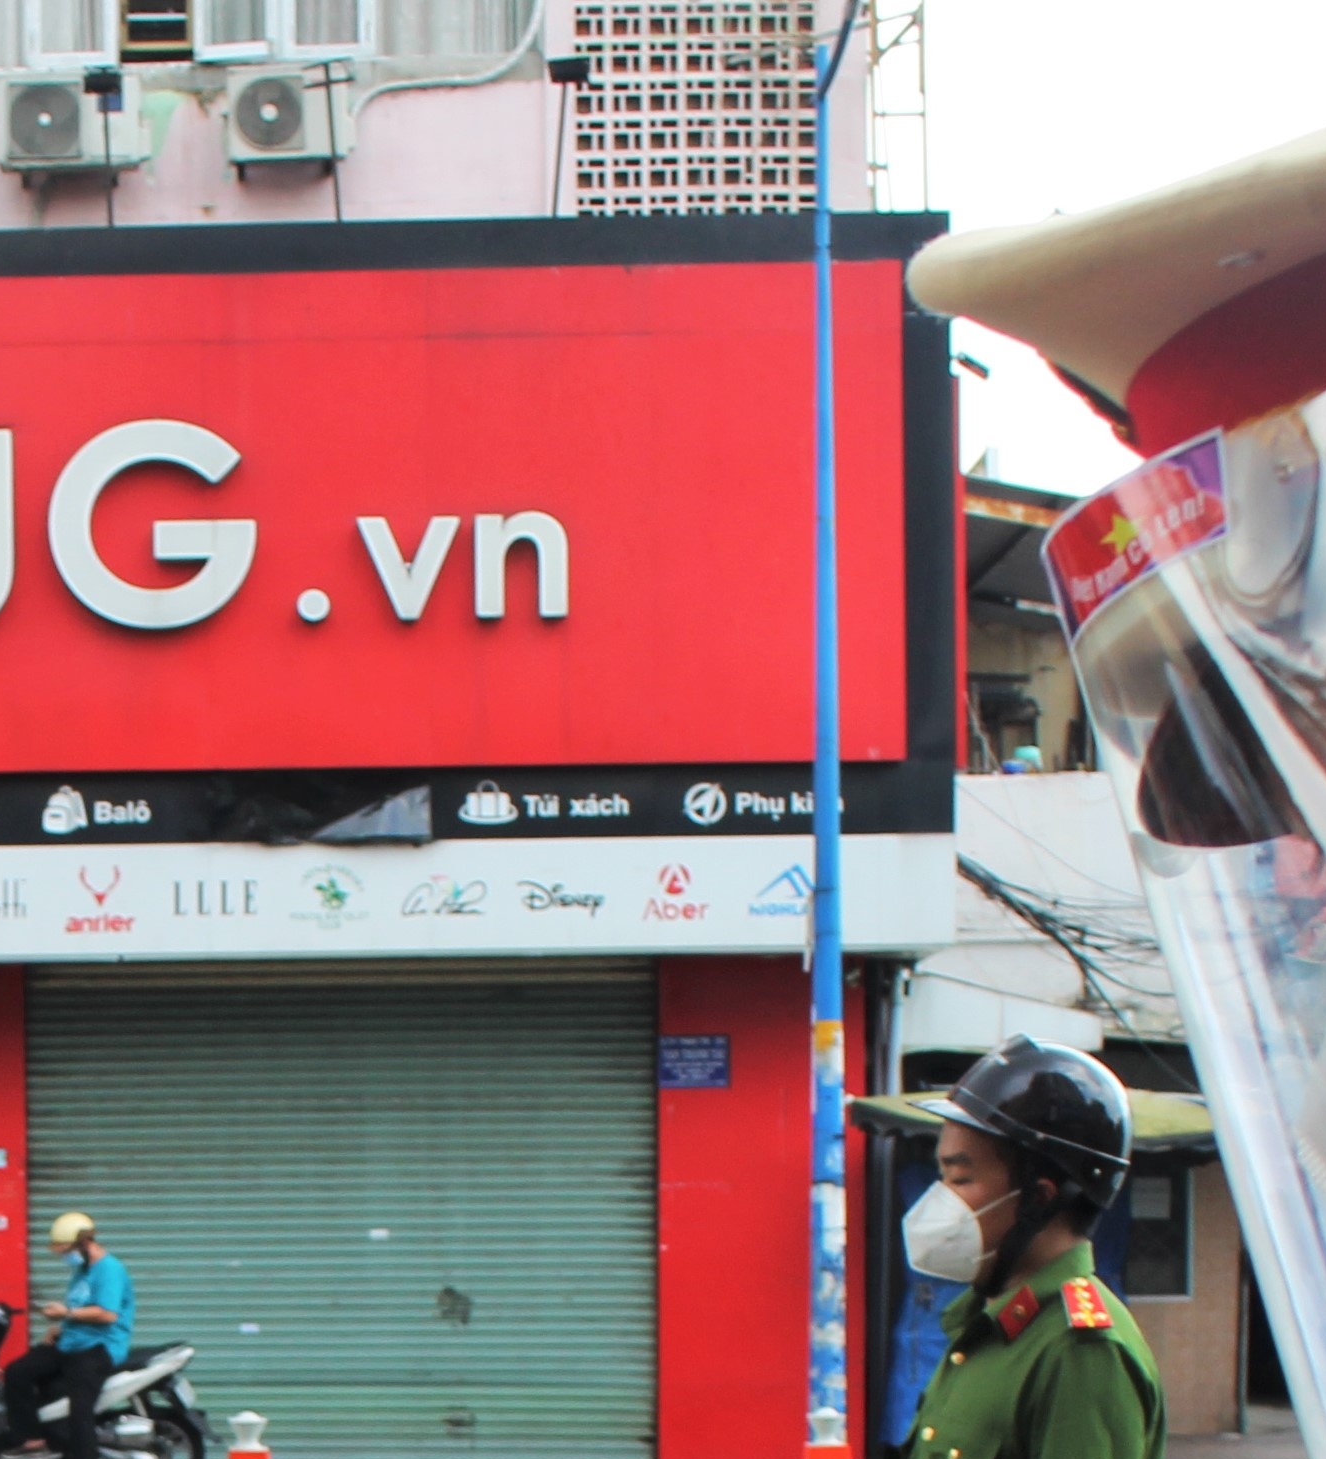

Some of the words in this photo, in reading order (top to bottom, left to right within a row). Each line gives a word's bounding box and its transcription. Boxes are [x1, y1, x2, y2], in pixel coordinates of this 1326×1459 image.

[93, 799, 152, 826] Balô
[524, 793, 560, 818] Túi
[570, 793, 630, 818] xách
[735, 791, 785, 822] Phụ
[790, 790, 844, 815] ki
[642, 896, 710, 922] Aber
